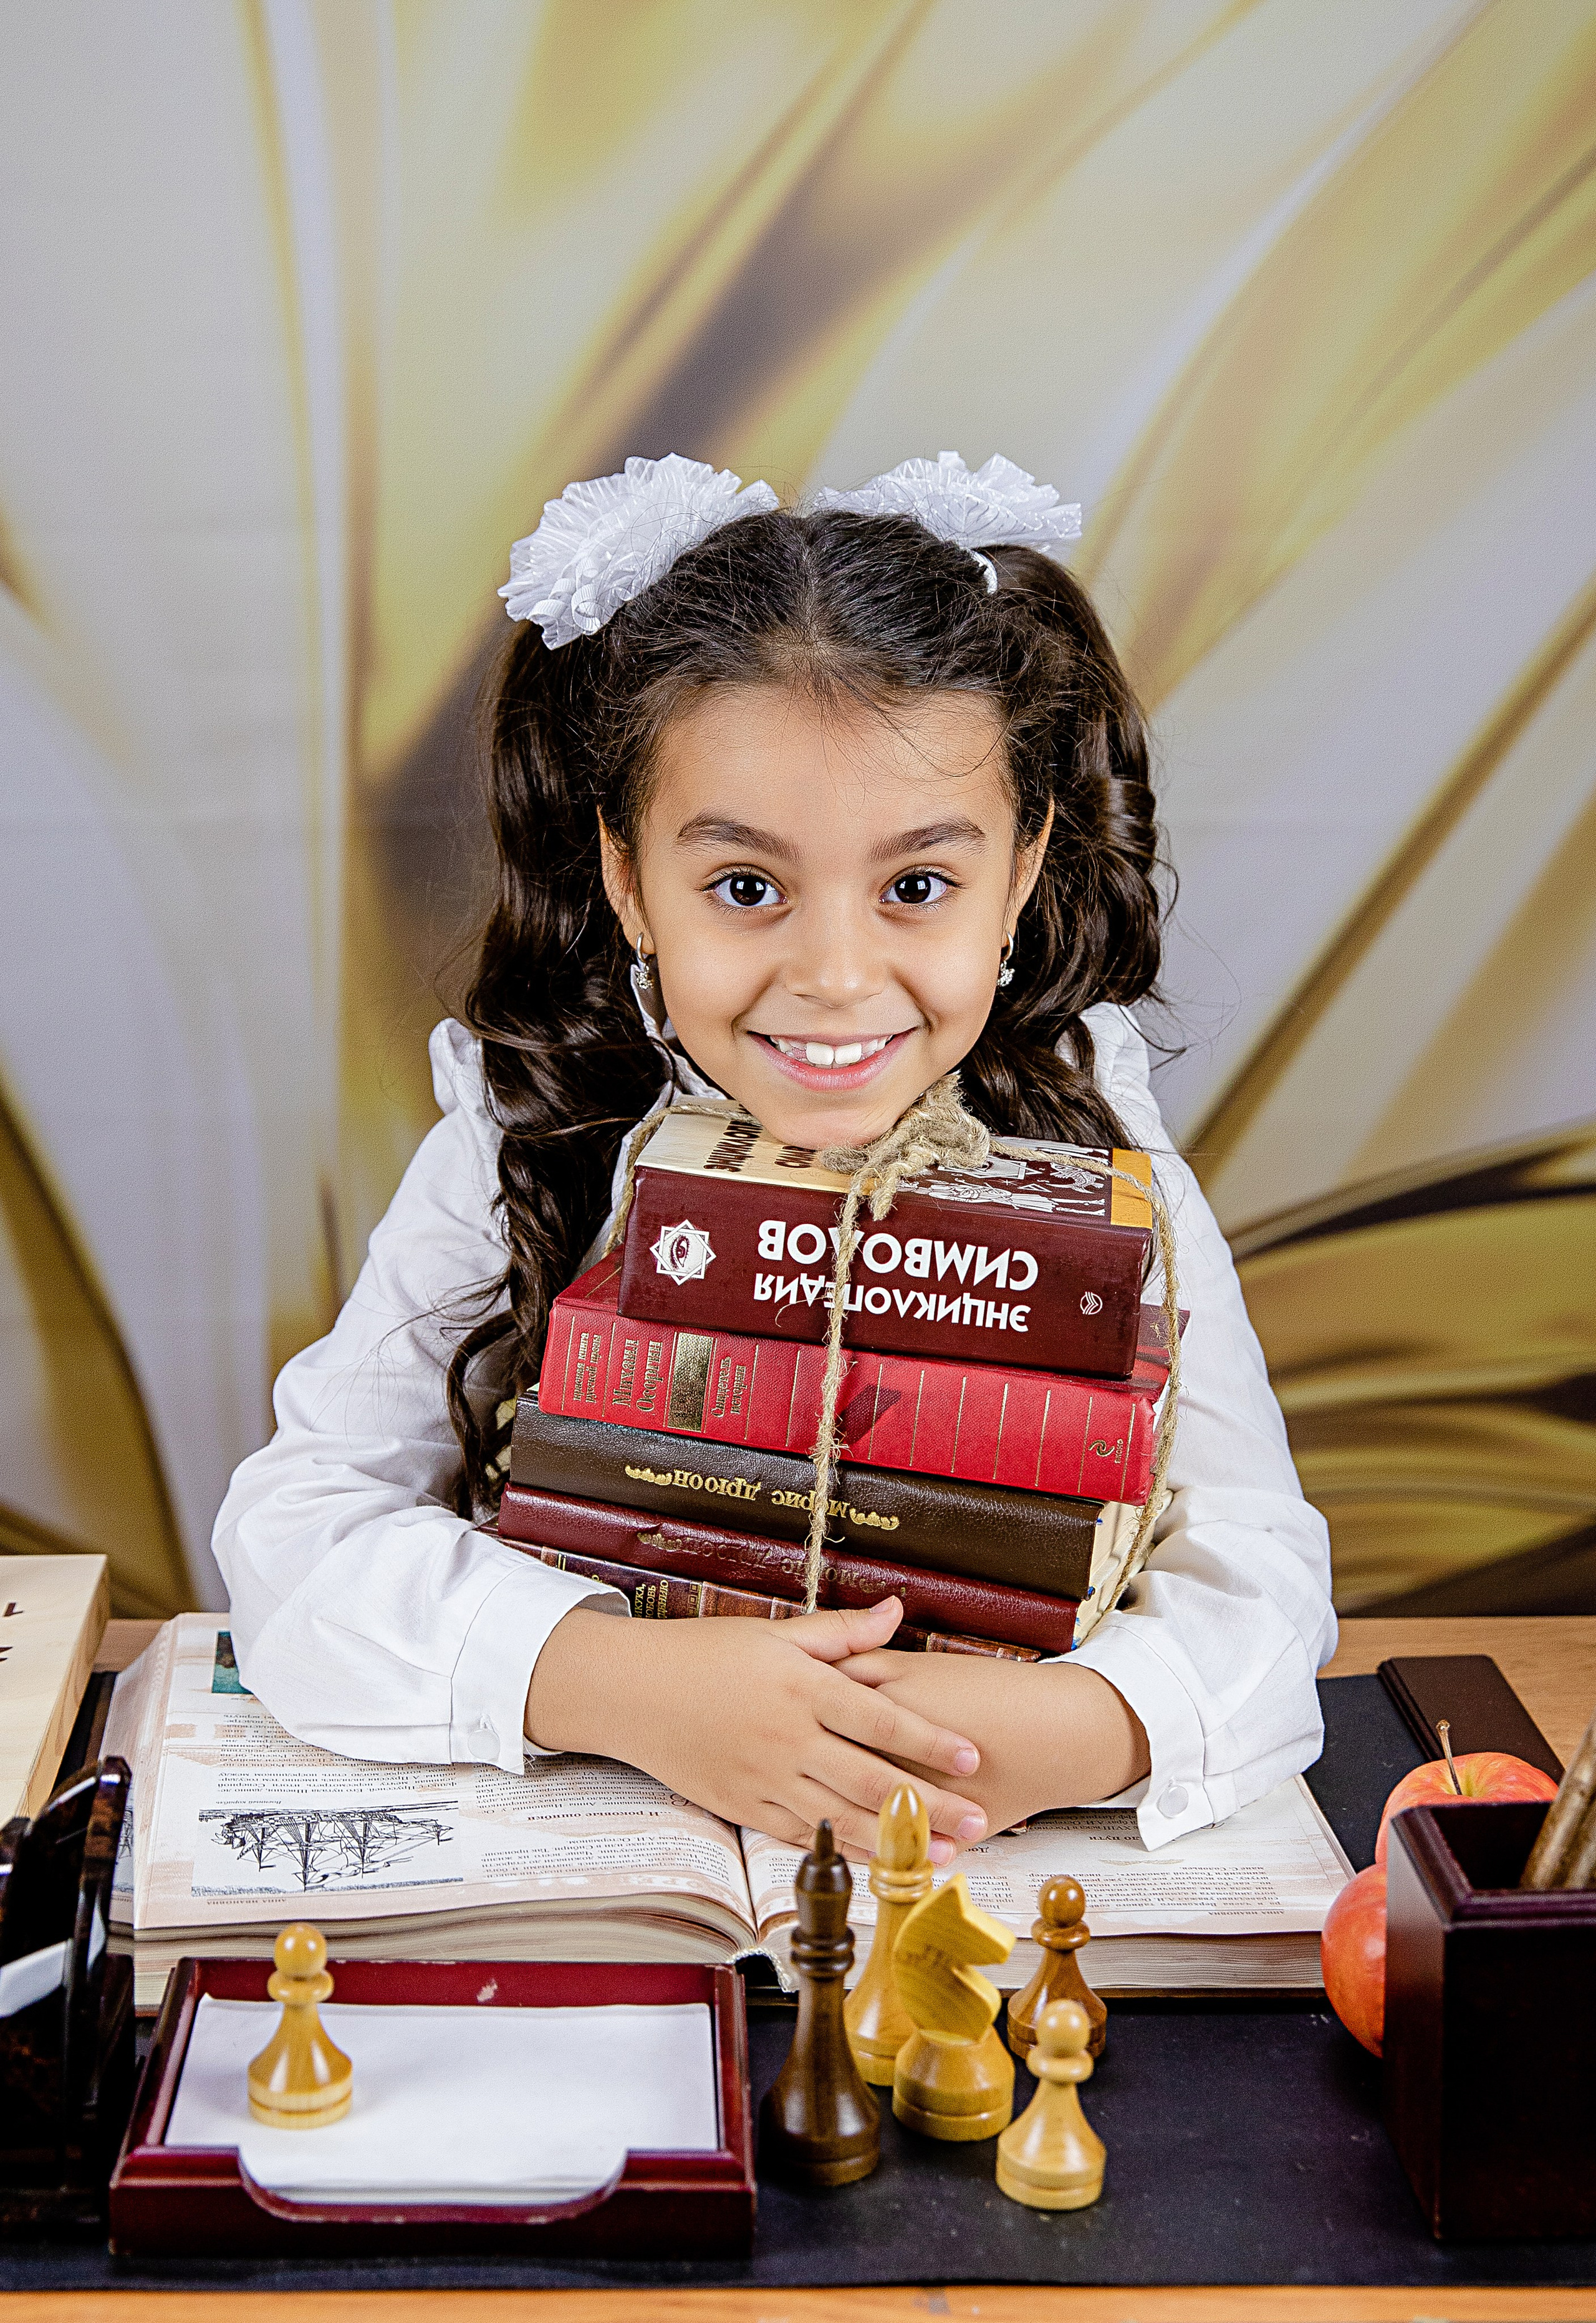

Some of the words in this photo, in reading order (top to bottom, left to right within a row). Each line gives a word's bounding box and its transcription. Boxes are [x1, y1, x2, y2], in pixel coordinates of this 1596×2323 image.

[774, 1146, 817, 1169] СИМВ
[753, 1272, 1031, 1332] ЭНЦИКЛОПЕДИЯ
[611, 1338, 639, 1407] Михаил
[635, 1340, 664, 1412] Осоргин
[711, 1356, 731, 1418] Свидетель
[731, 1365, 746, 1415] истории
[771, 1489, 851, 1519] мрис
[645, 1584, 656, 1618] ЮБОВЬ
